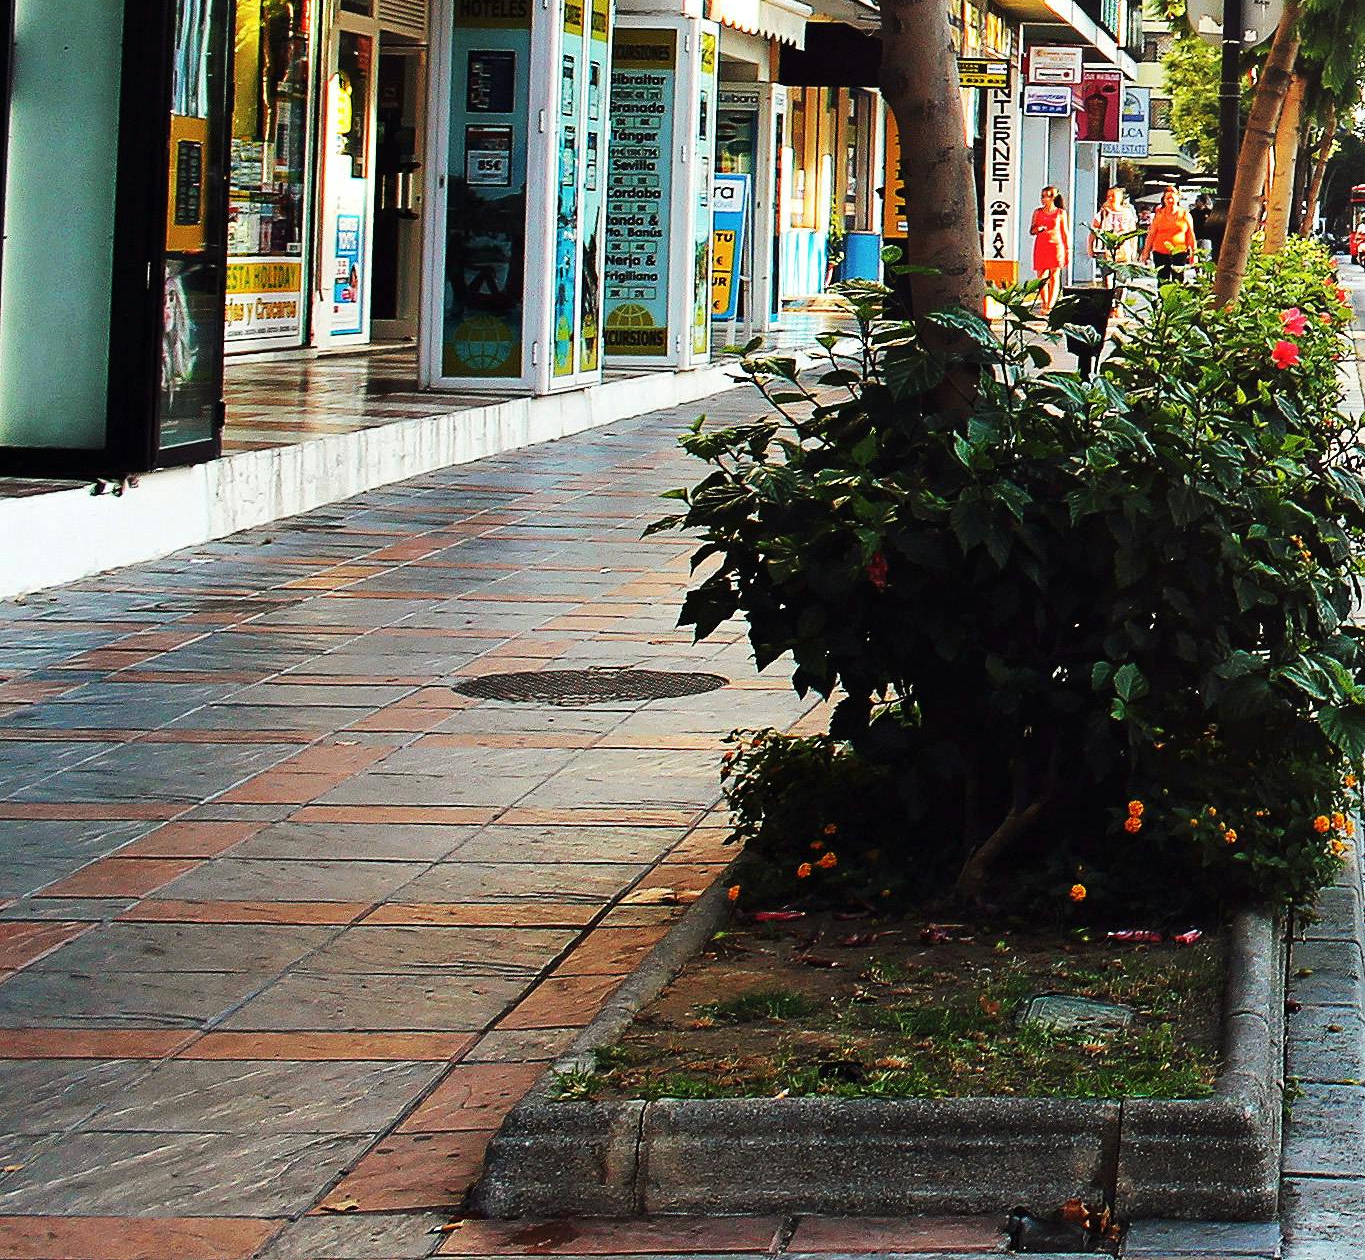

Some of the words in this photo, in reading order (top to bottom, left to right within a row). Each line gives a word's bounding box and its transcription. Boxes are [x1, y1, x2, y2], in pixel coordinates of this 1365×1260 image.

[460, 0, 528, 18] HOTELES
[1122, 144, 1146, 155] ESTATE
[992, 218, 1005, 259] FAX
